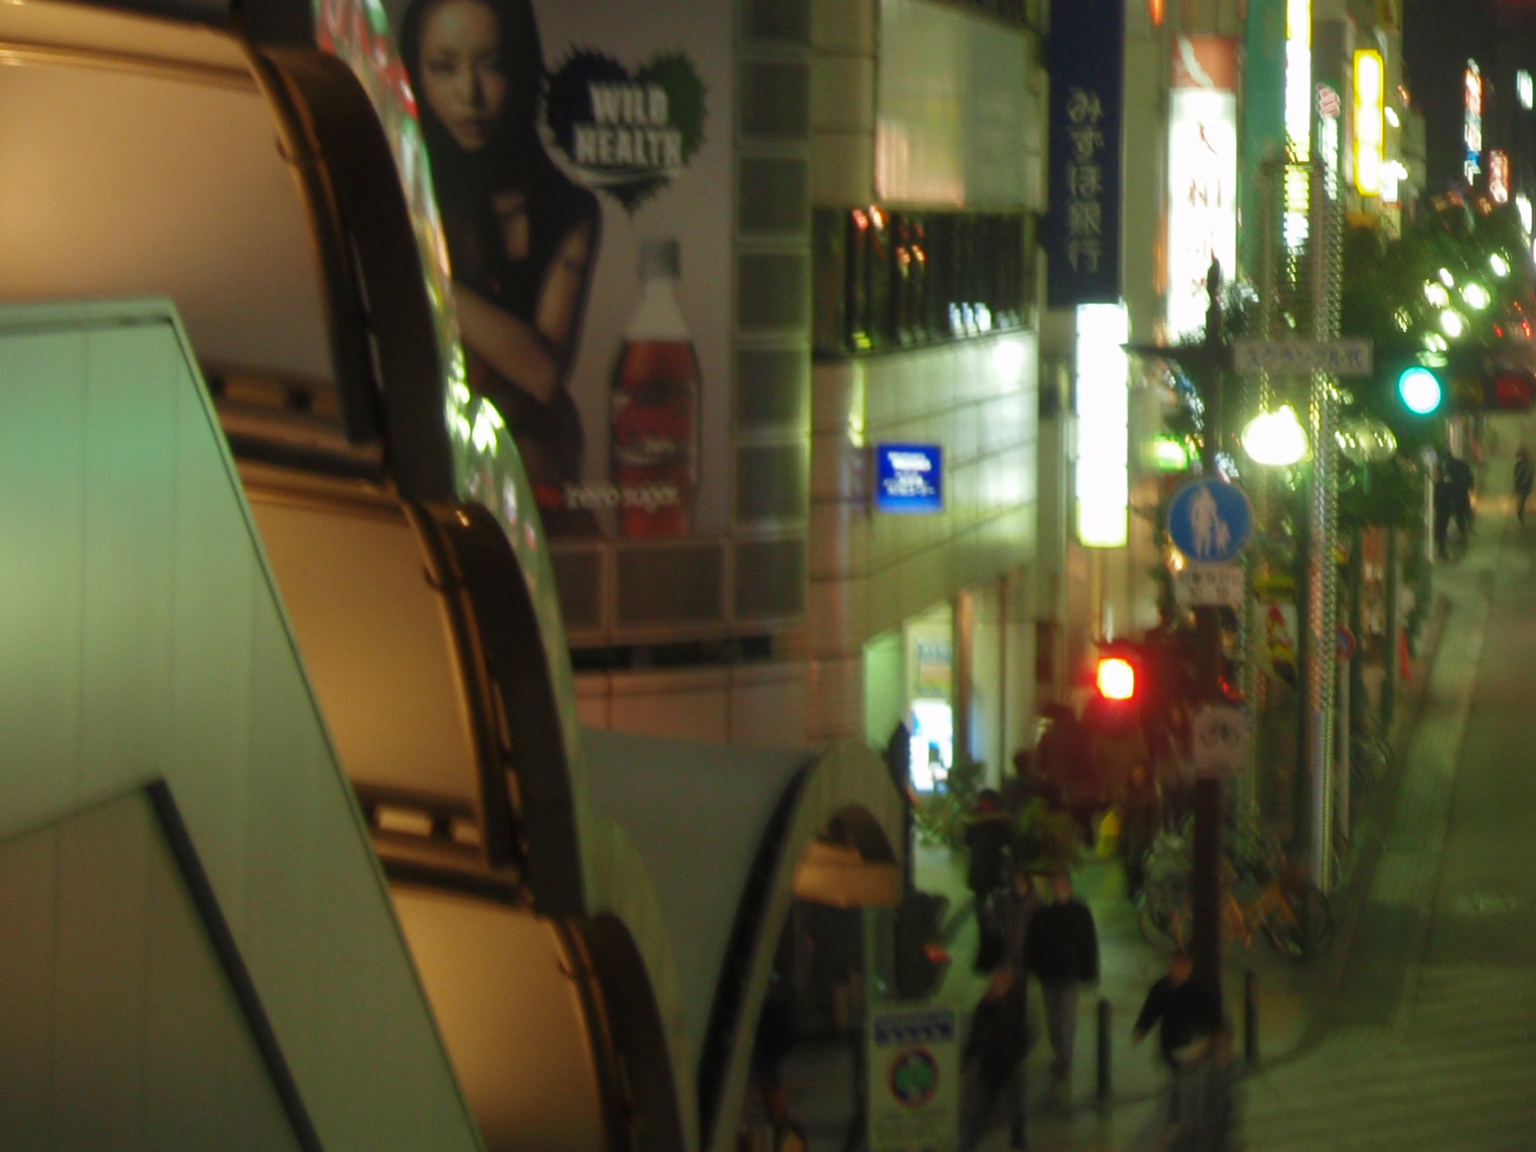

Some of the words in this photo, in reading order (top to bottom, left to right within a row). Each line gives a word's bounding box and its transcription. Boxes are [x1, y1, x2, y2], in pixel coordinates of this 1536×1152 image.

[585, 79, 669, 125] WILD
[573, 121, 684, 168] HEALTH
[1066, 86, 1105, 274] みずほ銀行
